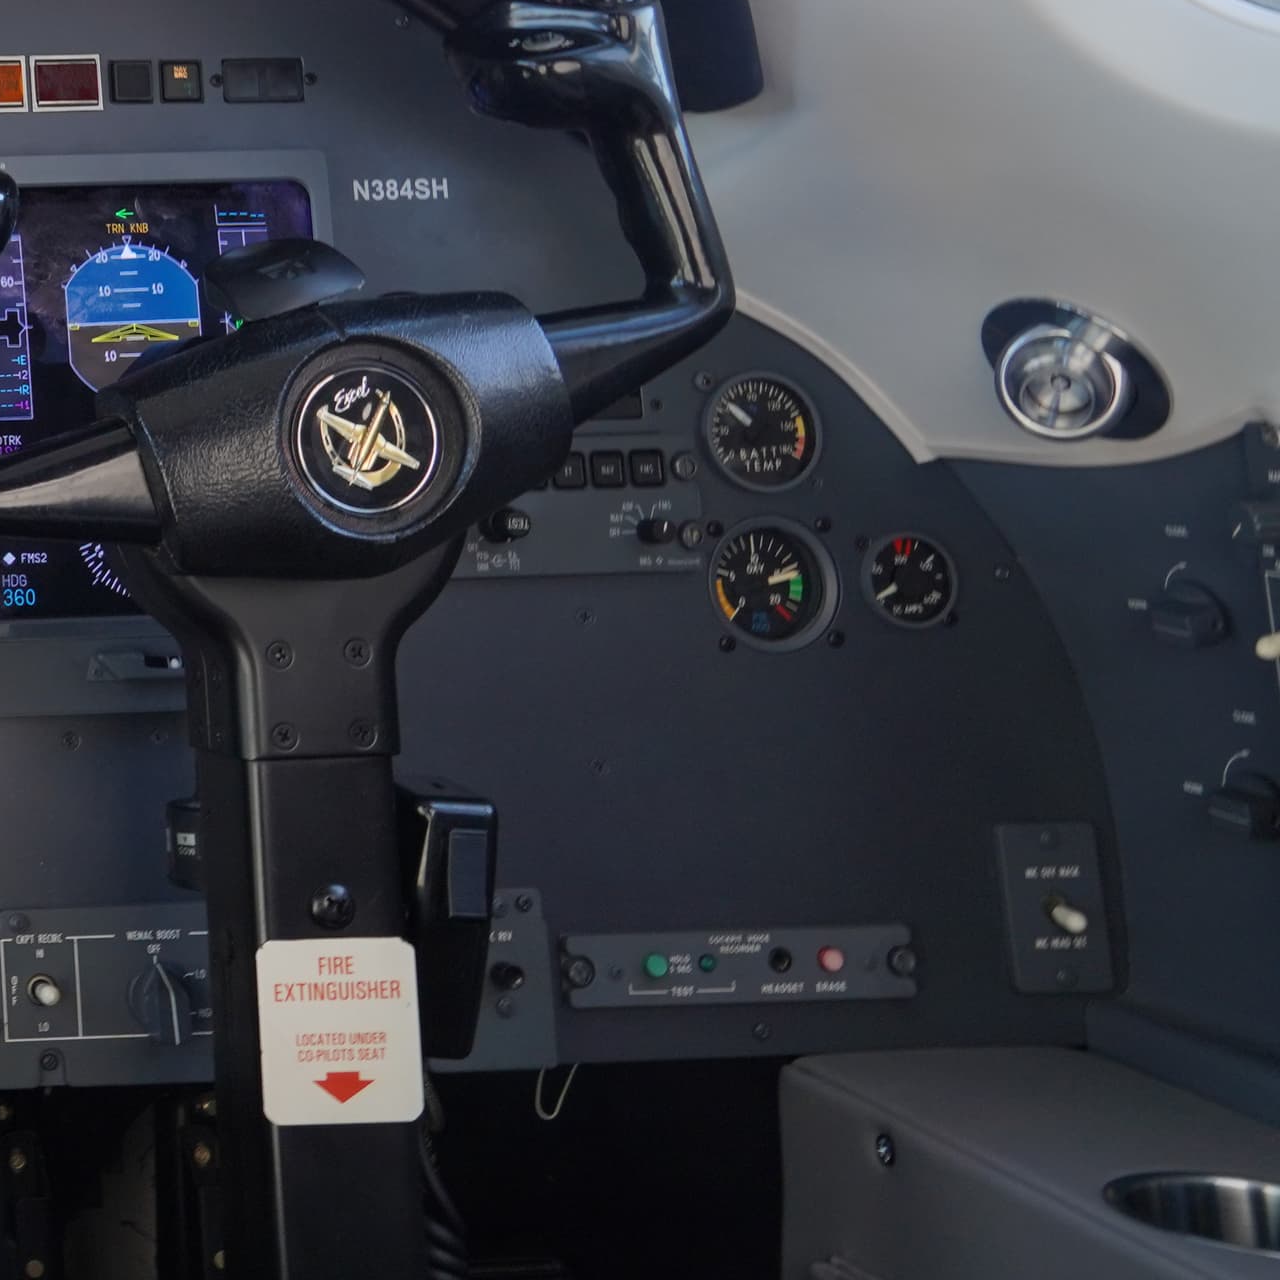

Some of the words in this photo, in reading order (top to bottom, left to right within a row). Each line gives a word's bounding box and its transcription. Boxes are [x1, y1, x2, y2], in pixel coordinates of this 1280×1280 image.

[353, 178, 449, 201] N384SH
[333, 375, 371, 413] Excel
[21, 553, 47, 564] FMS2
[2, 575, 27, 587] HDG
[3, 589, 36, 606] 360
[318, 956, 354, 976] FIRE
[273, 980, 401, 1002] EXTINGUISHER
[296, 1033, 345, 1046] LOCATED
[349, 1032, 386, 1045] UNDER
[358, 1047, 386, 1061] SEAT
